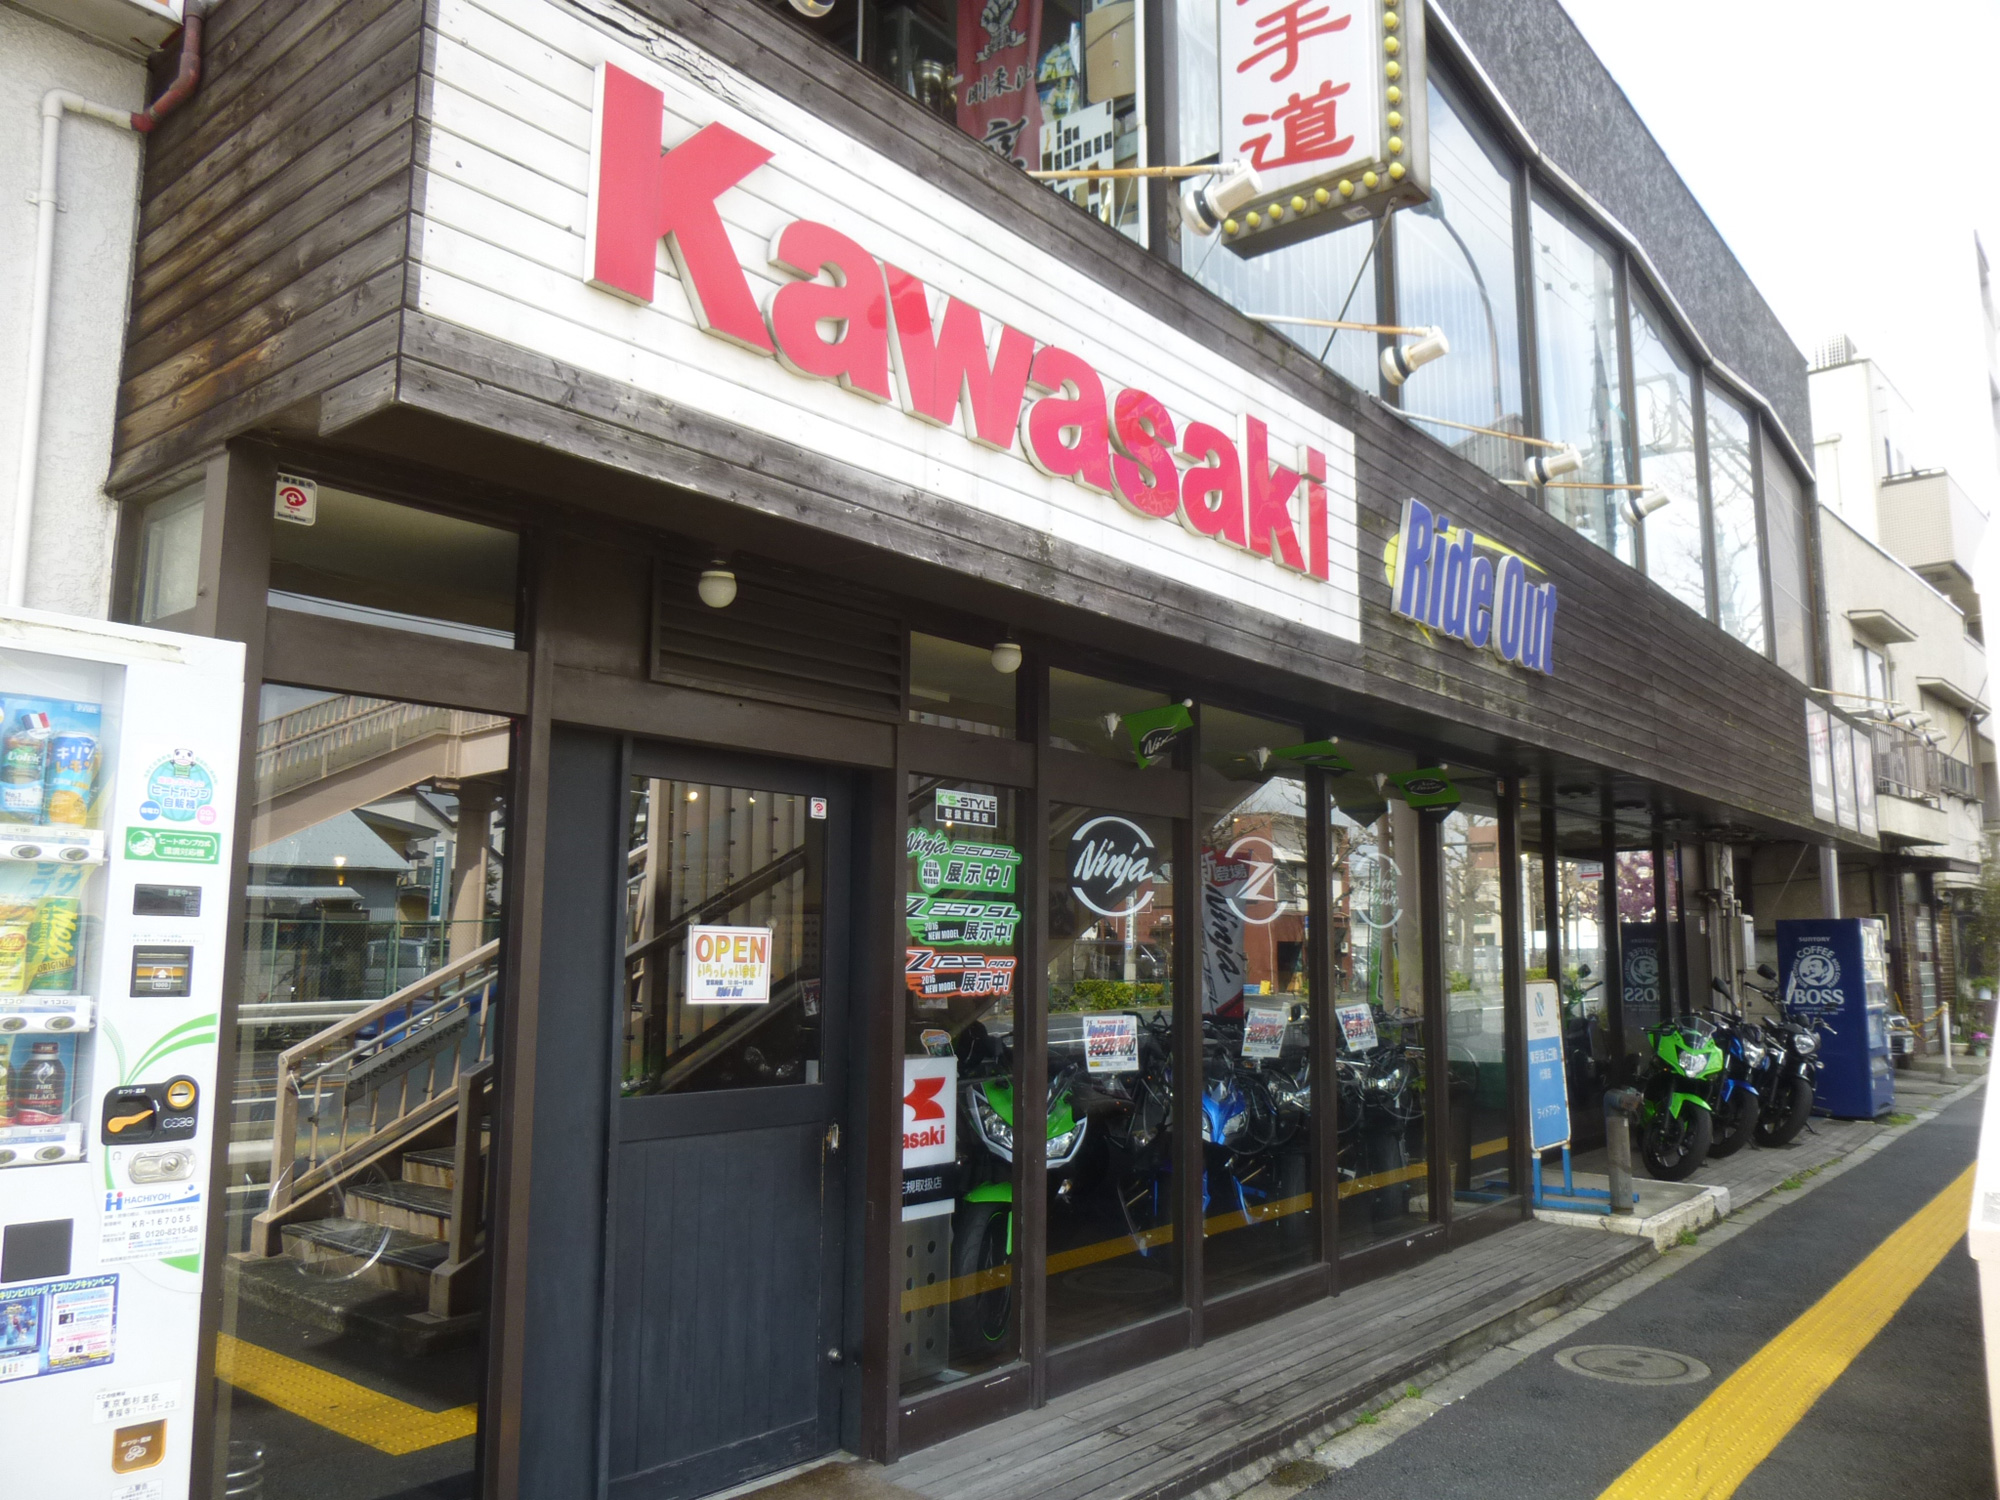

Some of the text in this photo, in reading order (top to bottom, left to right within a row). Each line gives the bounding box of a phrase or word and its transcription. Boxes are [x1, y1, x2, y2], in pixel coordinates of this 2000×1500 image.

[1235, 0, 1355, 171] 手道
[586, 64, 1329, 582] Kawasaki
[1392, 497, 1558, 677] Ride Out
[163, 797, 196, 810] 自販機
[944, 808, 989, 823] 取扱販売店
[907, 831, 1021, 862] Ninja 250SL
[923, 868, 940, 878] NEW
[1073, 838, 1154, 894] Ninja
[48, 905, 78, 959] Mets
[927, 928, 960, 941] NEW MODEL
[1205, 883, 1241, 985] Ninja
[695, 934, 767, 964] OPEN
[1796, 945, 1835, 959] COFFEE
[37, 957, 73, 973] ORIGINAL
[987, 958, 1016, 968] PRO
[924, 981, 957, 994] NEW MODEL
[1794, 988, 1844, 1005] BOSS
[1536, 1104, 1561, 1121] ライドアウト
[902, 1124, 946, 1149] asaki
[124, 1192, 171, 1205] HACHIYOH
[144, 1224, 199, 1239] 0120-8215-88
[50, 1276, 117, 1293] スプリングキャンペーン
[102, 1393, 160, 1409] 東京都杉並区
